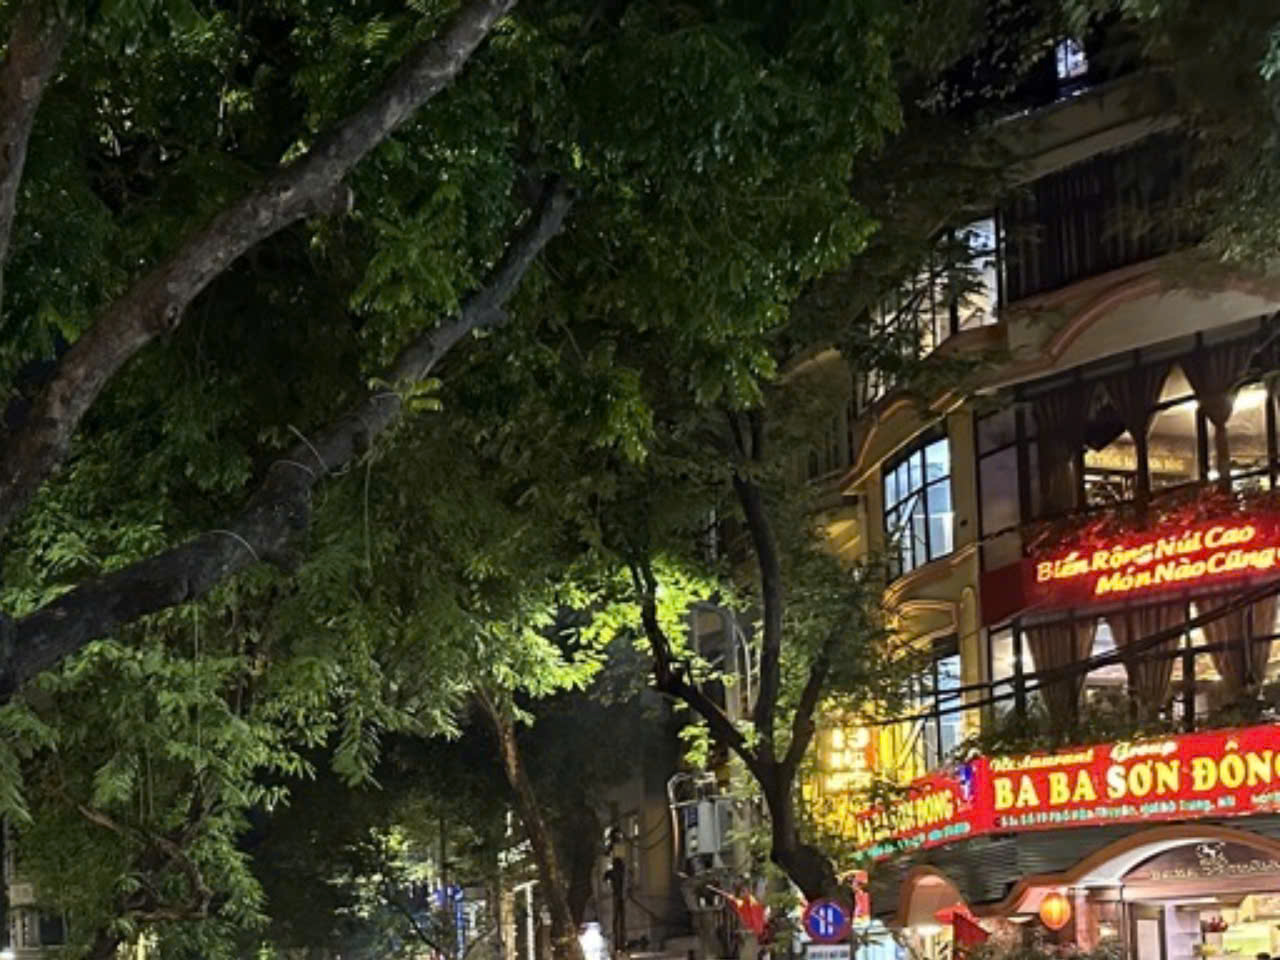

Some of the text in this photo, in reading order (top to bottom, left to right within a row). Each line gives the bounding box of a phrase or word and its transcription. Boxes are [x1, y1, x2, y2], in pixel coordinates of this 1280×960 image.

[1204, 525, 1256, 549] Cao
[994, 775, 1040, 811] BA
[1048, 769, 1097, 806] BA
[1106, 759, 1180, 800] SƠN
